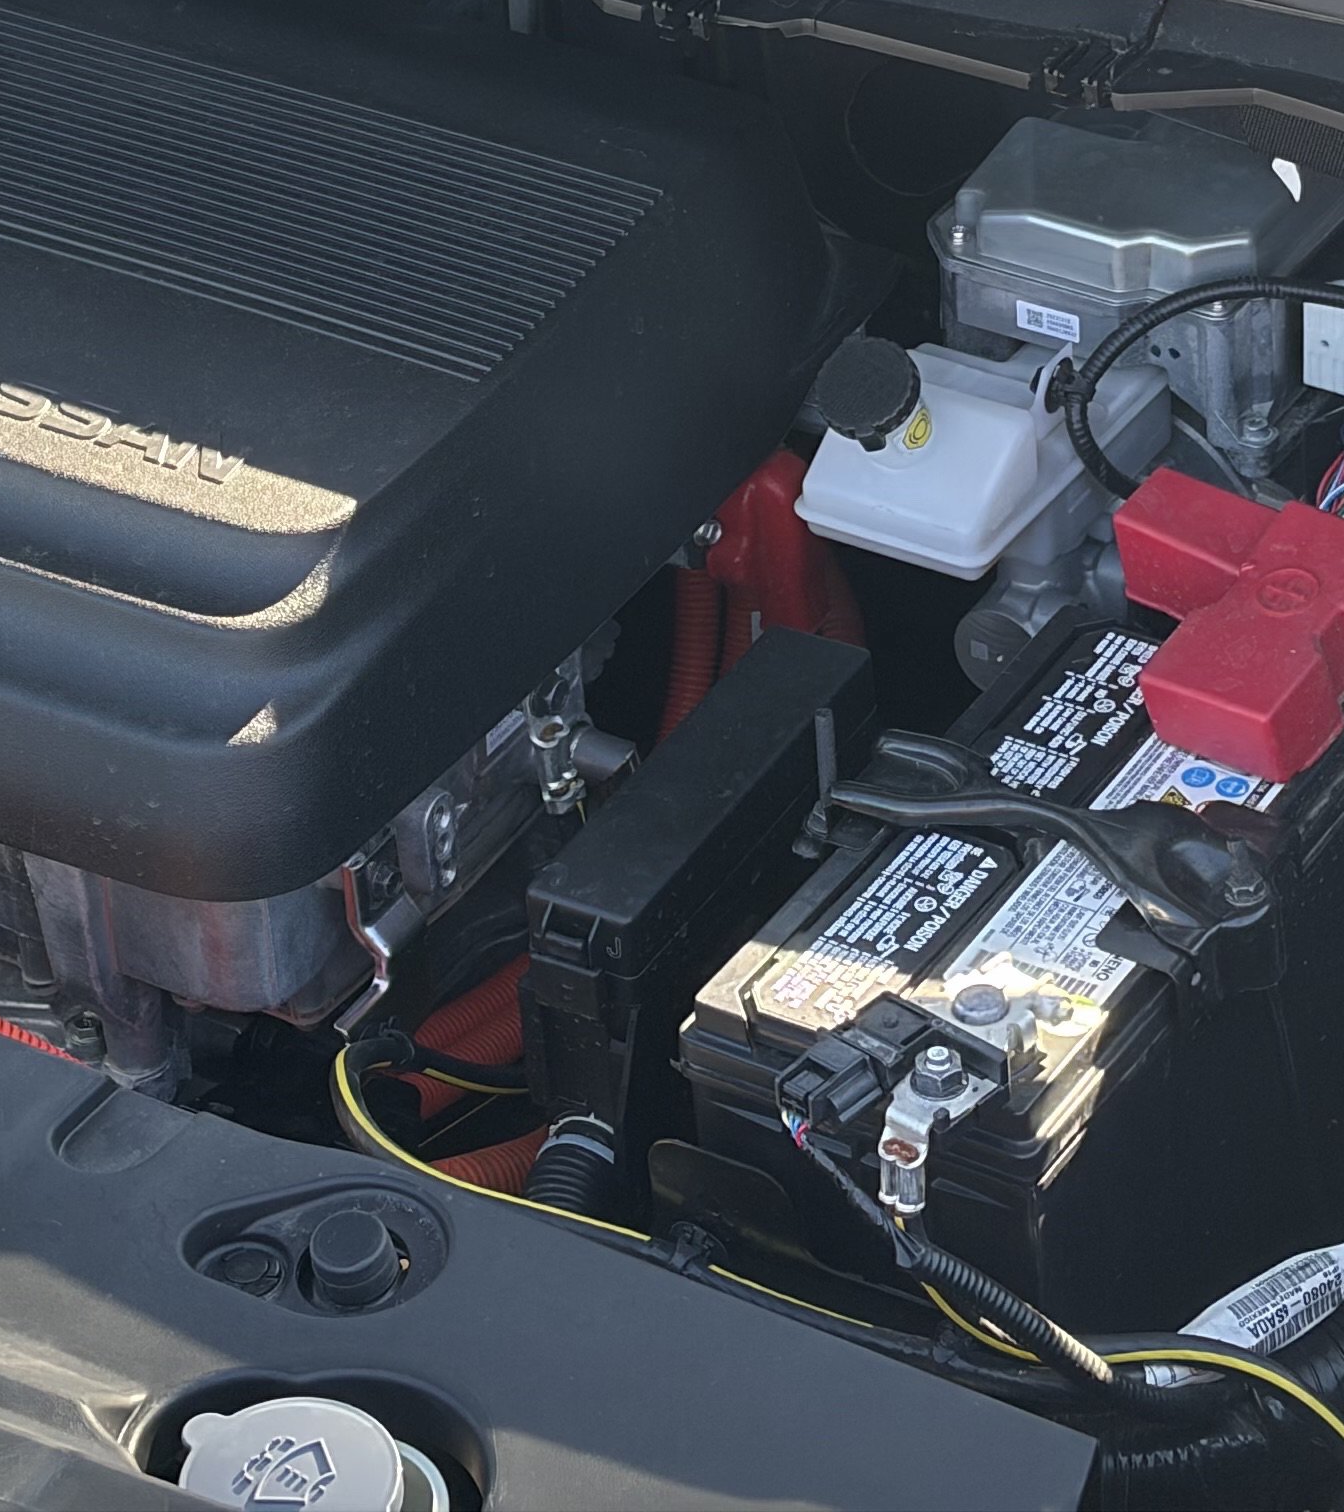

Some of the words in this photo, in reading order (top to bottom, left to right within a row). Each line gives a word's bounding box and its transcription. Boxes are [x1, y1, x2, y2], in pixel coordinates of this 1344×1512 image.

[1091, 711, 1130, 747] POISON
[946, 869, 989, 910] DANGER
[903, 914, 946, 953] POISON
[1239, 1304, 1271, 1328] MEXICO
